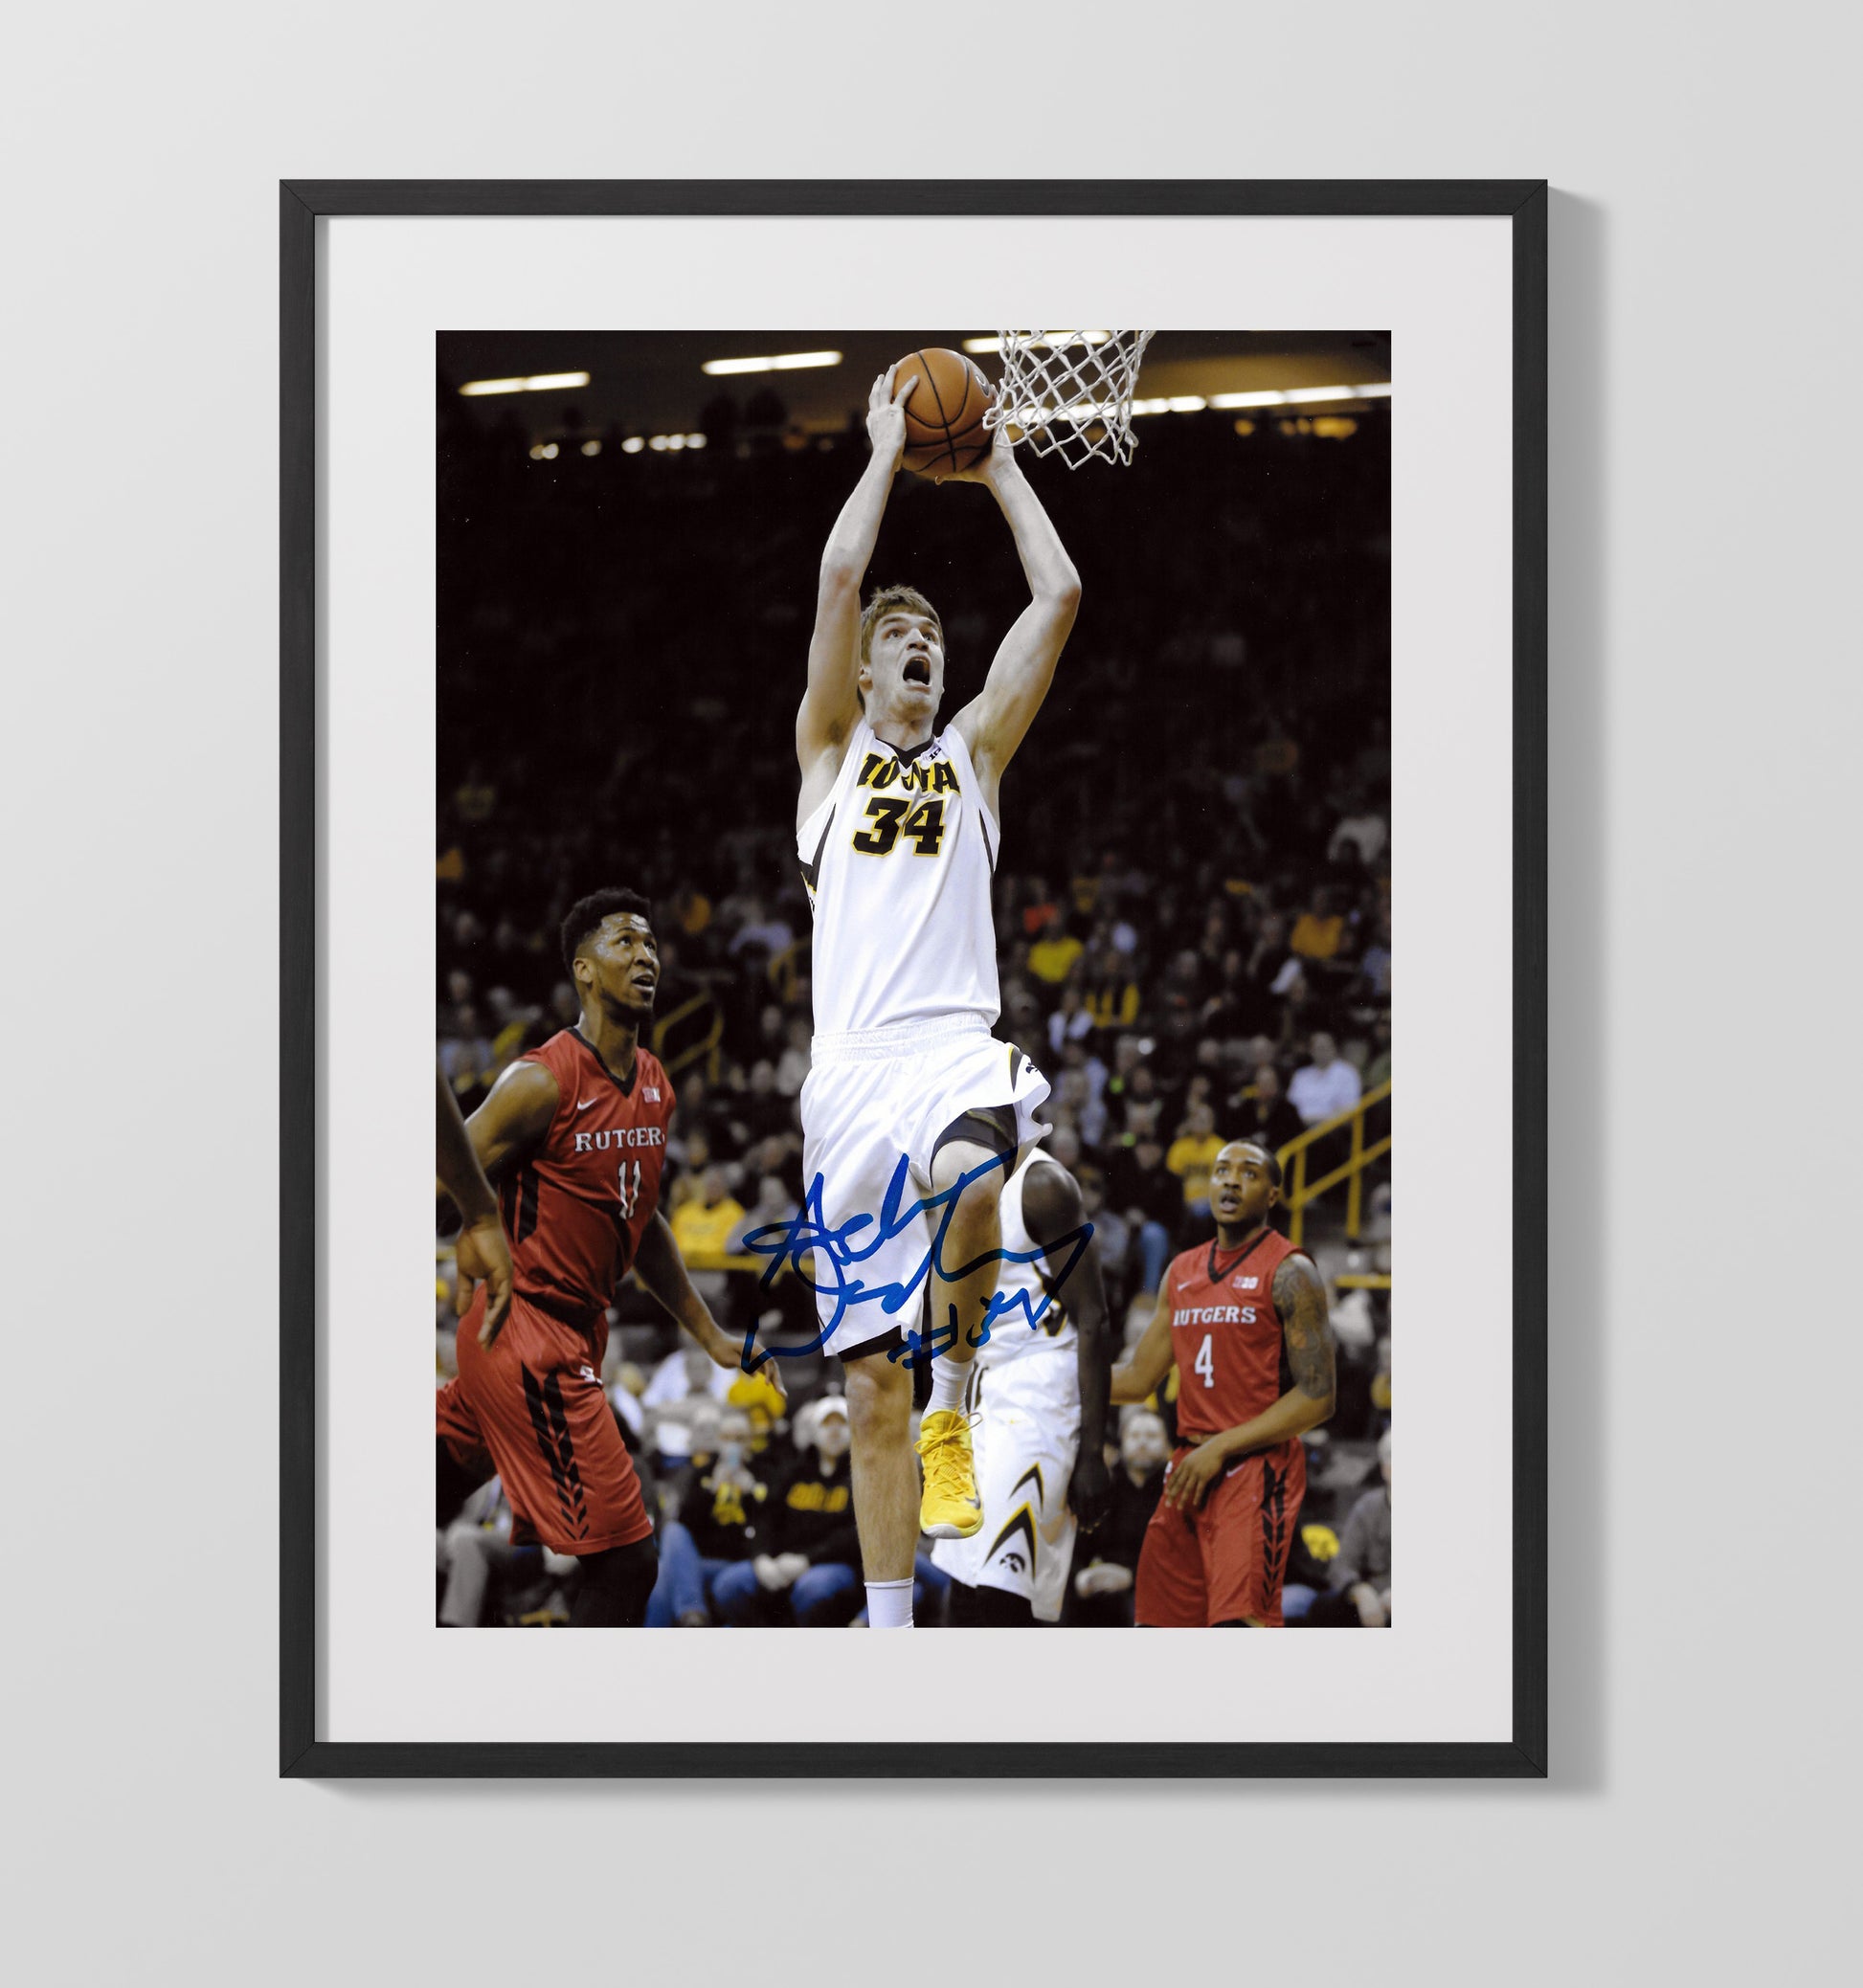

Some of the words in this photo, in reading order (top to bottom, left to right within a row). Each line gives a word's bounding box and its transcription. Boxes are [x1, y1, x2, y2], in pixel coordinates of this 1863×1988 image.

[856, 751, 961, 795] IOWA
[851, 796, 946, 857] 34
[574, 1126, 665, 1152] RUTGER
[618, 1159, 641, 1220] 11
[1194, 1332, 1214, 1389] 4
